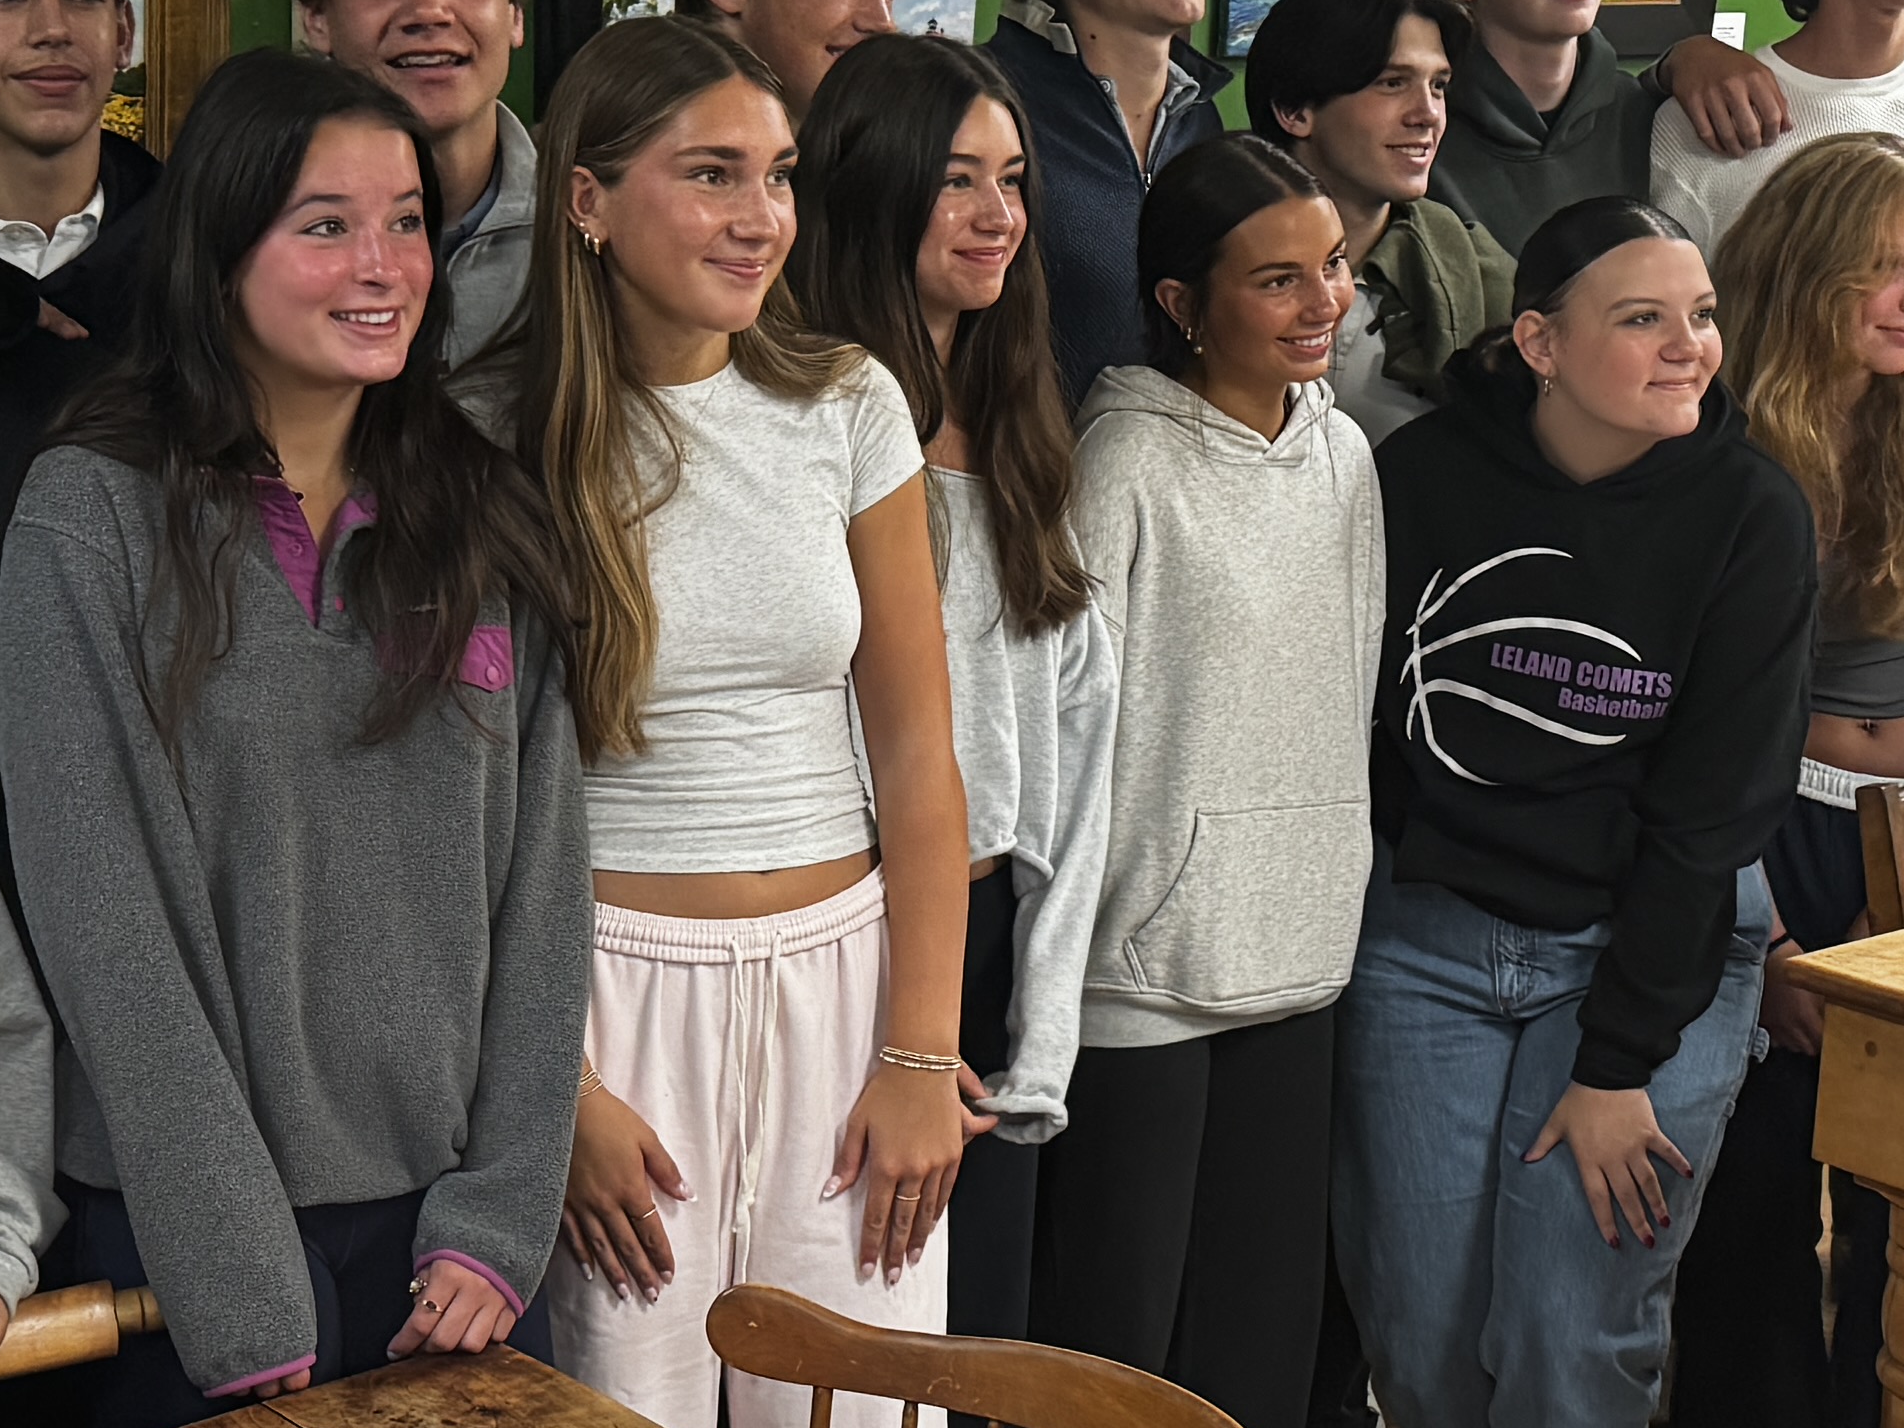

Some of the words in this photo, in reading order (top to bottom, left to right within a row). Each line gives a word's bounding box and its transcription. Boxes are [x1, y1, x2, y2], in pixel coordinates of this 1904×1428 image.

[1490, 643, 1571, 684] LELAND
[1576, 661, 1673, 698] COMETS
[1558, 687, 1669, 720] Basketball
